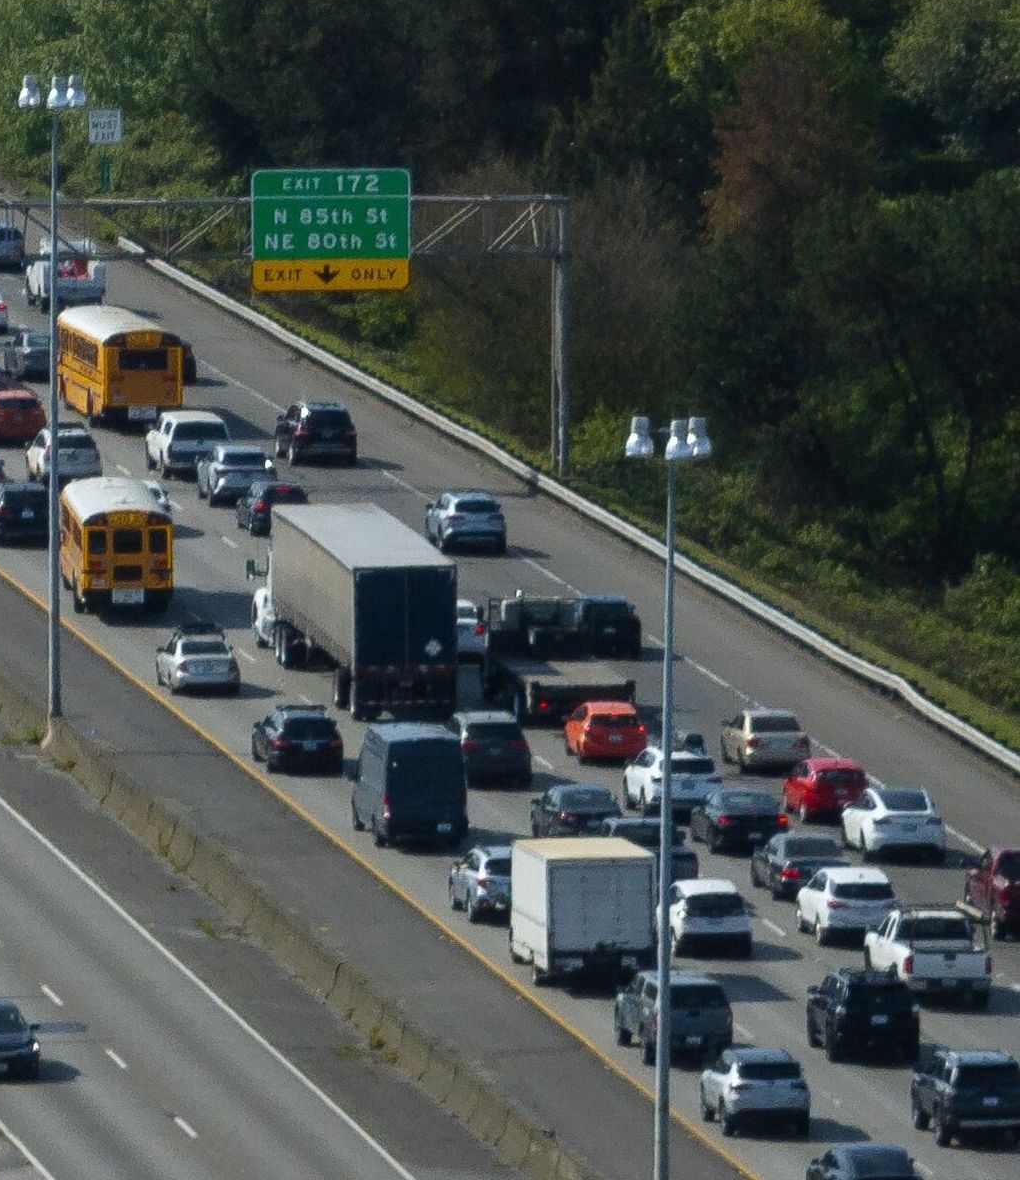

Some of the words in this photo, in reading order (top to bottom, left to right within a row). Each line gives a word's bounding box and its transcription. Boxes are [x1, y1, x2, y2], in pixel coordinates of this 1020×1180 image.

[282, 177, 321, 191] EXIT
[336, 174, 380, 192] 172
[274, 207, 288, 225] N
[299, 207, 354, 225] 85th
[366, 207, 389, 225] St
[264, 232, 295, 250] NE
[307, 232, 363, 250] 80th
[375, 232, 398, 250] St
[263, 268, 302, 283] EXIT
[351, 267, 398, 282] ONLY
